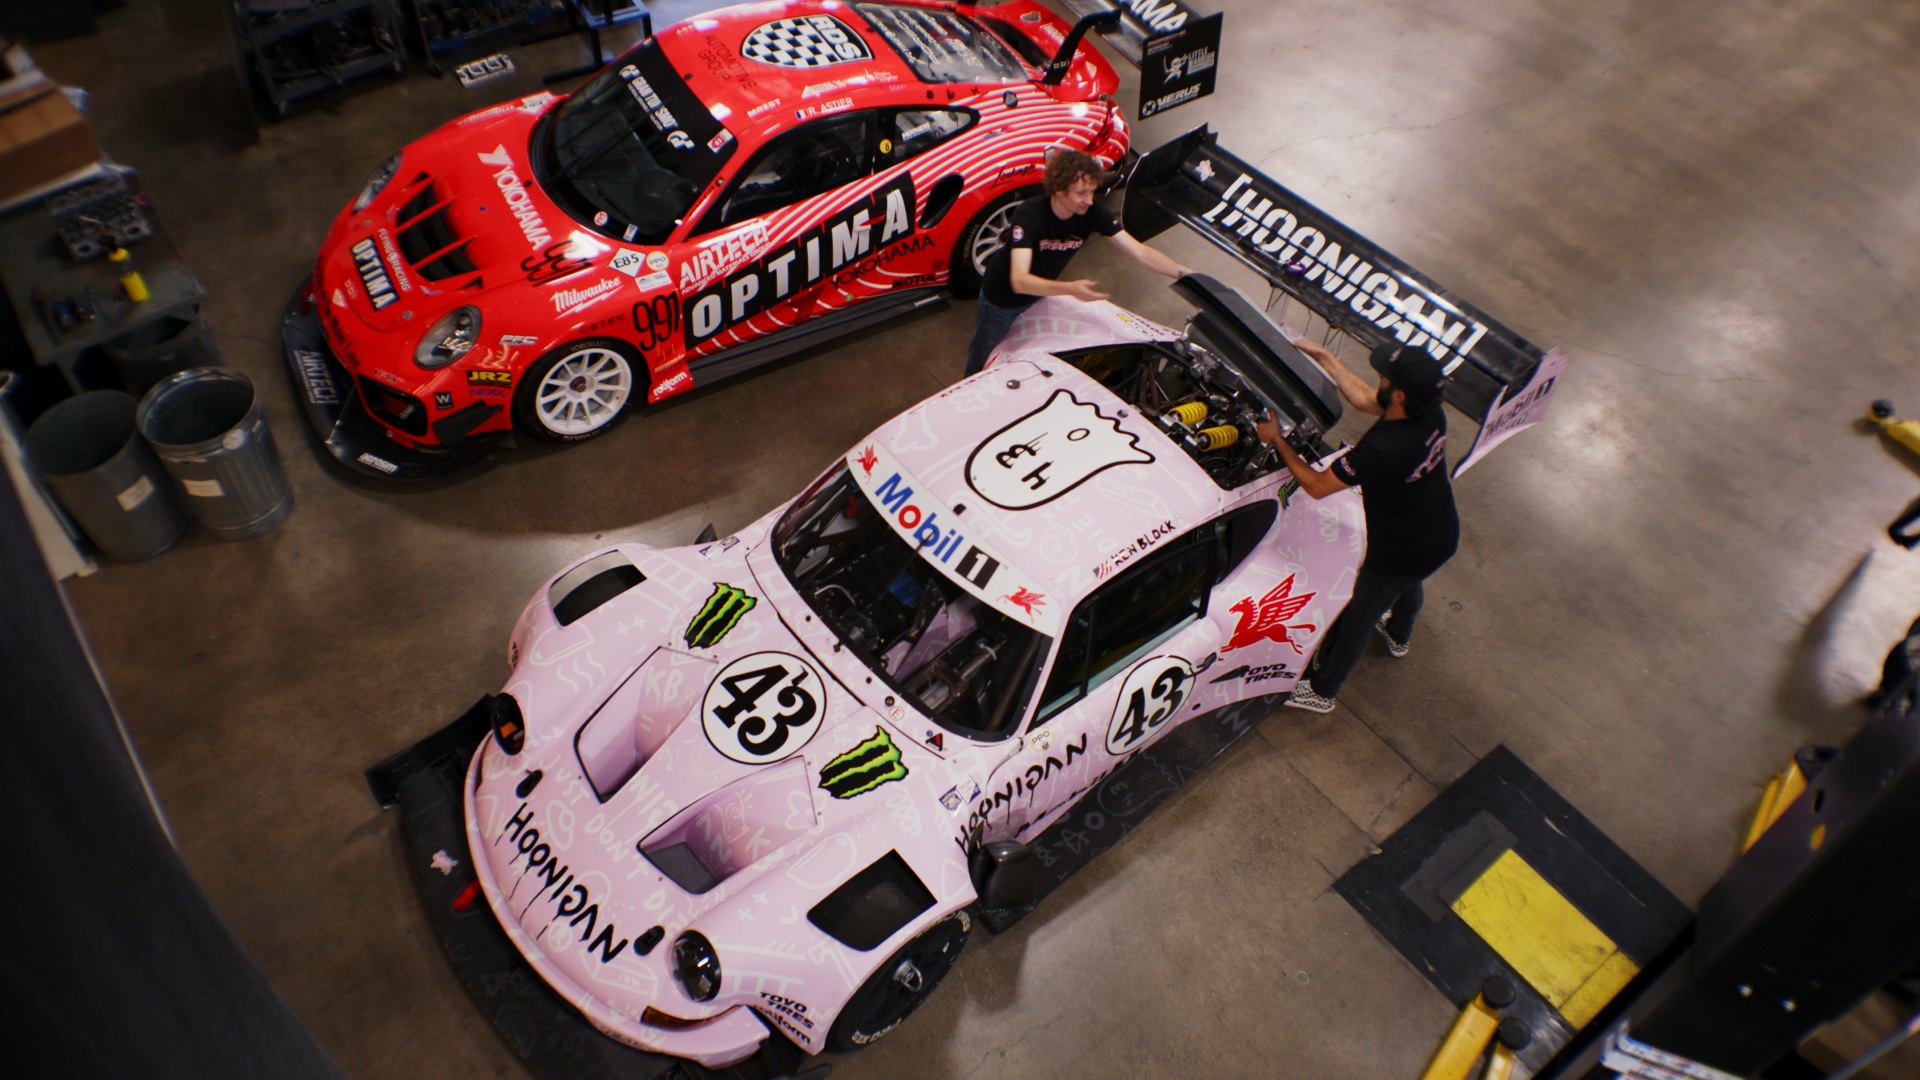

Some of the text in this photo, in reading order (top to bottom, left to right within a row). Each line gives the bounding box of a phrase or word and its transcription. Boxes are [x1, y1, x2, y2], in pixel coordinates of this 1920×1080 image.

[809, 16, 862, 60] RDS
[698, 50, 732, 81] GROUP
[704, 33, 758, 91] AUTOMOTIVE
[631, 76, 653, 98] GRAN
[820, 97, 854, 114] ASTIER
[1157, 83, 1202, 105] VERUS
[492, 164, 553, 252] YOKOHAMA
[377, 228, 412, 292] FLYING RACING
[613, 254, 640, 269] E85
[679, 217, 771, 290] AIRTECH
[692, 189, 910, 338] OPTIMA
[829, 233, 937, 290] YOKOHAMA
[352, 238, 399, 310] OPTIMA
[891, 272, 937, 289] MOTUL
[550, 276, 622, 313] Milwaukee
[631, 290, 680, 352] 991
[468, 370, 512, 383] JRZ
[653, 371, 688, 397] rotiform
[874, 472, 989, 582] Mobil 1
[1112, 519, 1177, 567] KEN BLOCK
[1243, 670, 1298, 685] TIRES
[711, 664, 818, 756] 43
[1112, 665, 1186, 749] 43
[1030, 730, 1051, 746] PPO
[957, 779, 972, 792] TECH
[496, 801, 630, 964] HOONIGAN
[759, 991, 808, 1014] TOYO
[767, 1000, 816, 1030] TIRES
